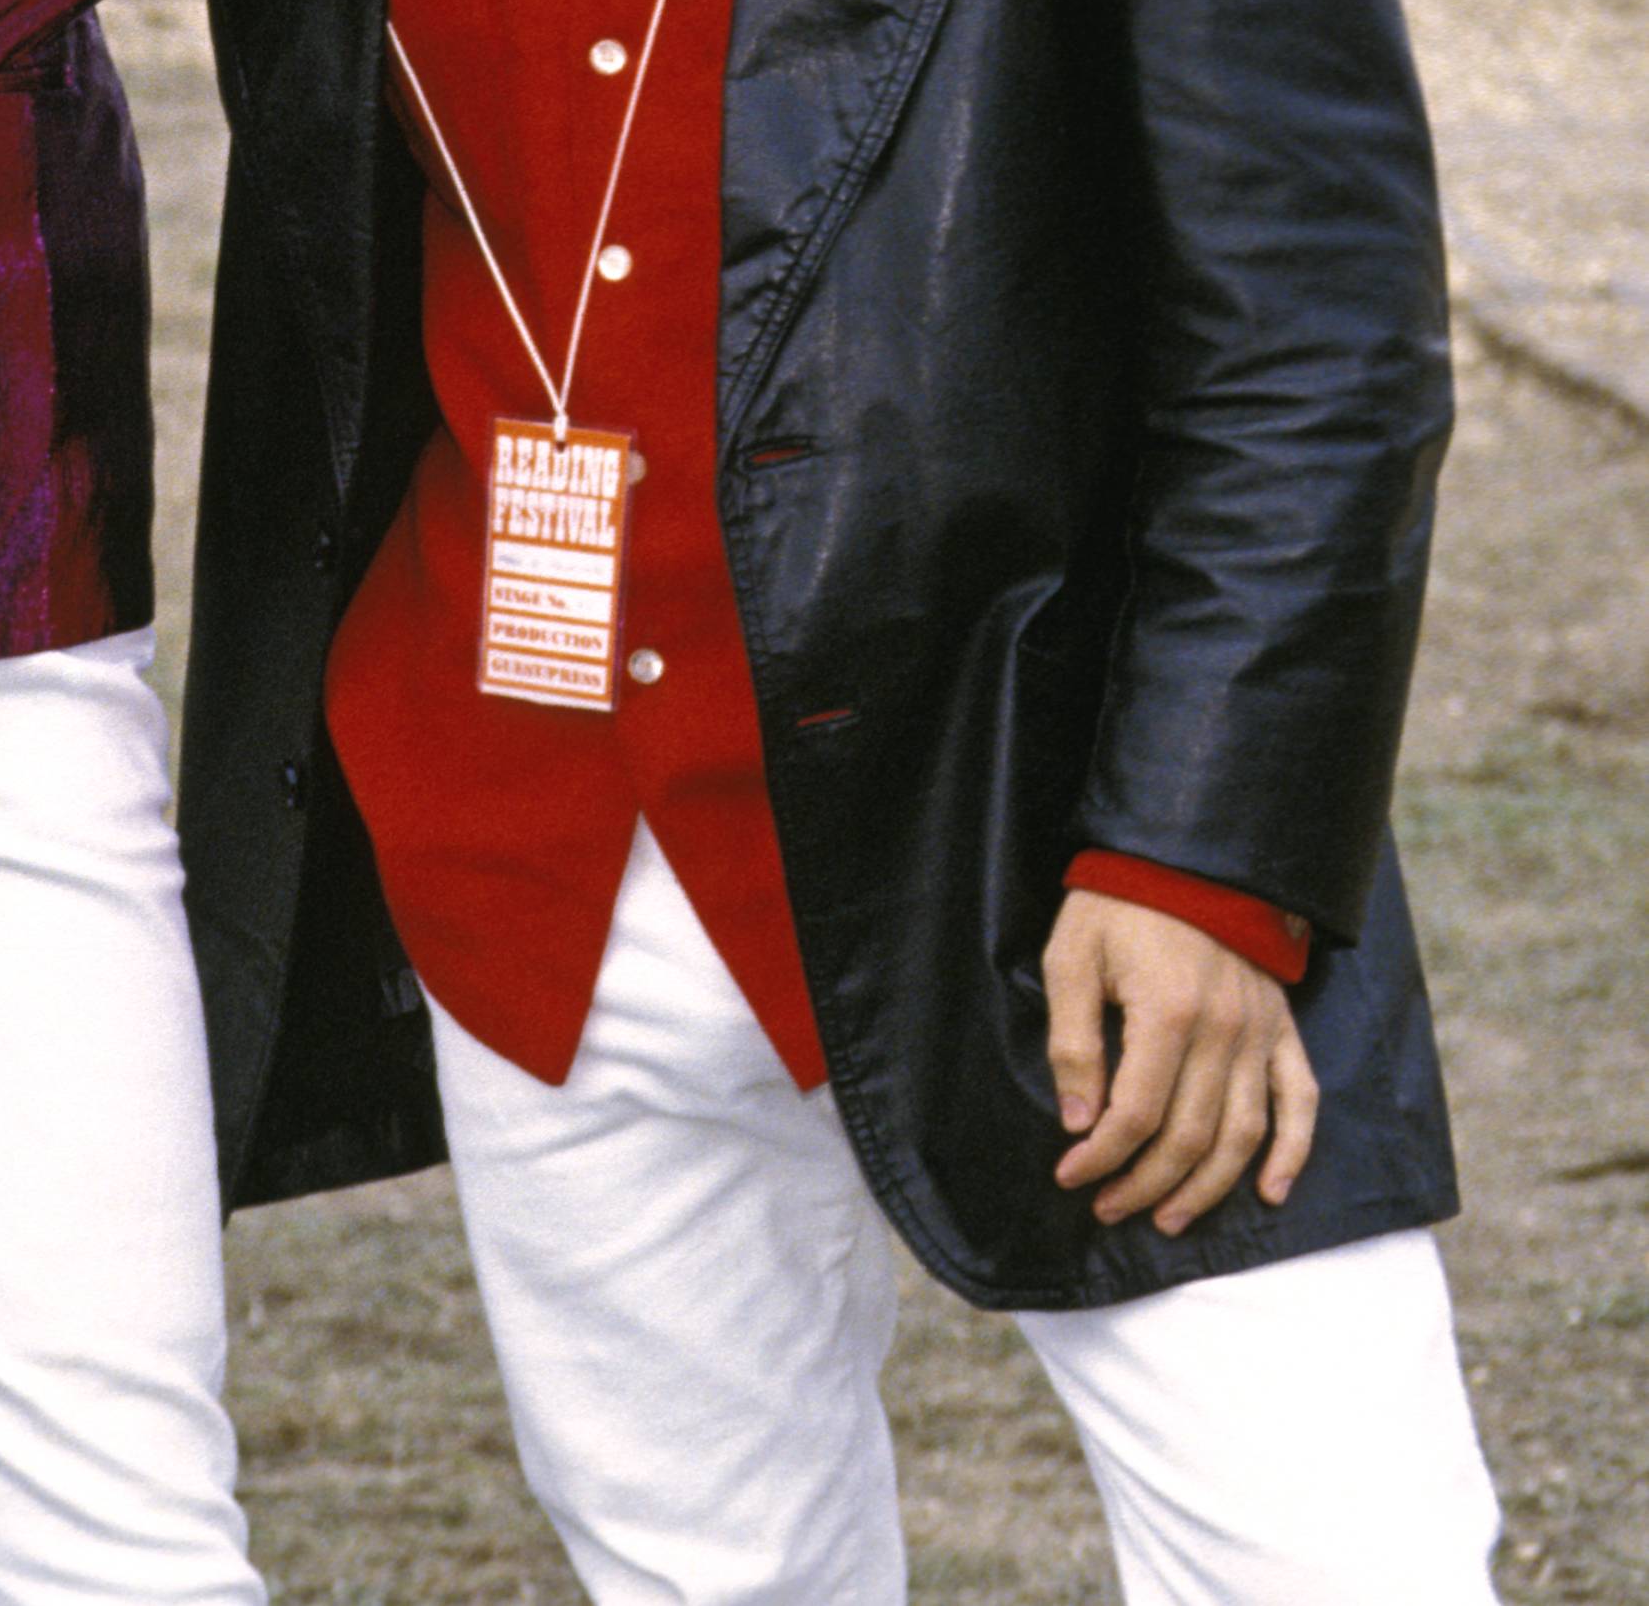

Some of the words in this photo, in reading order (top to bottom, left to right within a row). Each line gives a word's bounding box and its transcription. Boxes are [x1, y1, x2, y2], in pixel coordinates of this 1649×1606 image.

[496, 435, 620, 498] READING
[493, 486, 616, 548] FESTIVAL
[494, 587, 540, 606] STAGE
[493, 621, 603, 650] PRODUCTION
